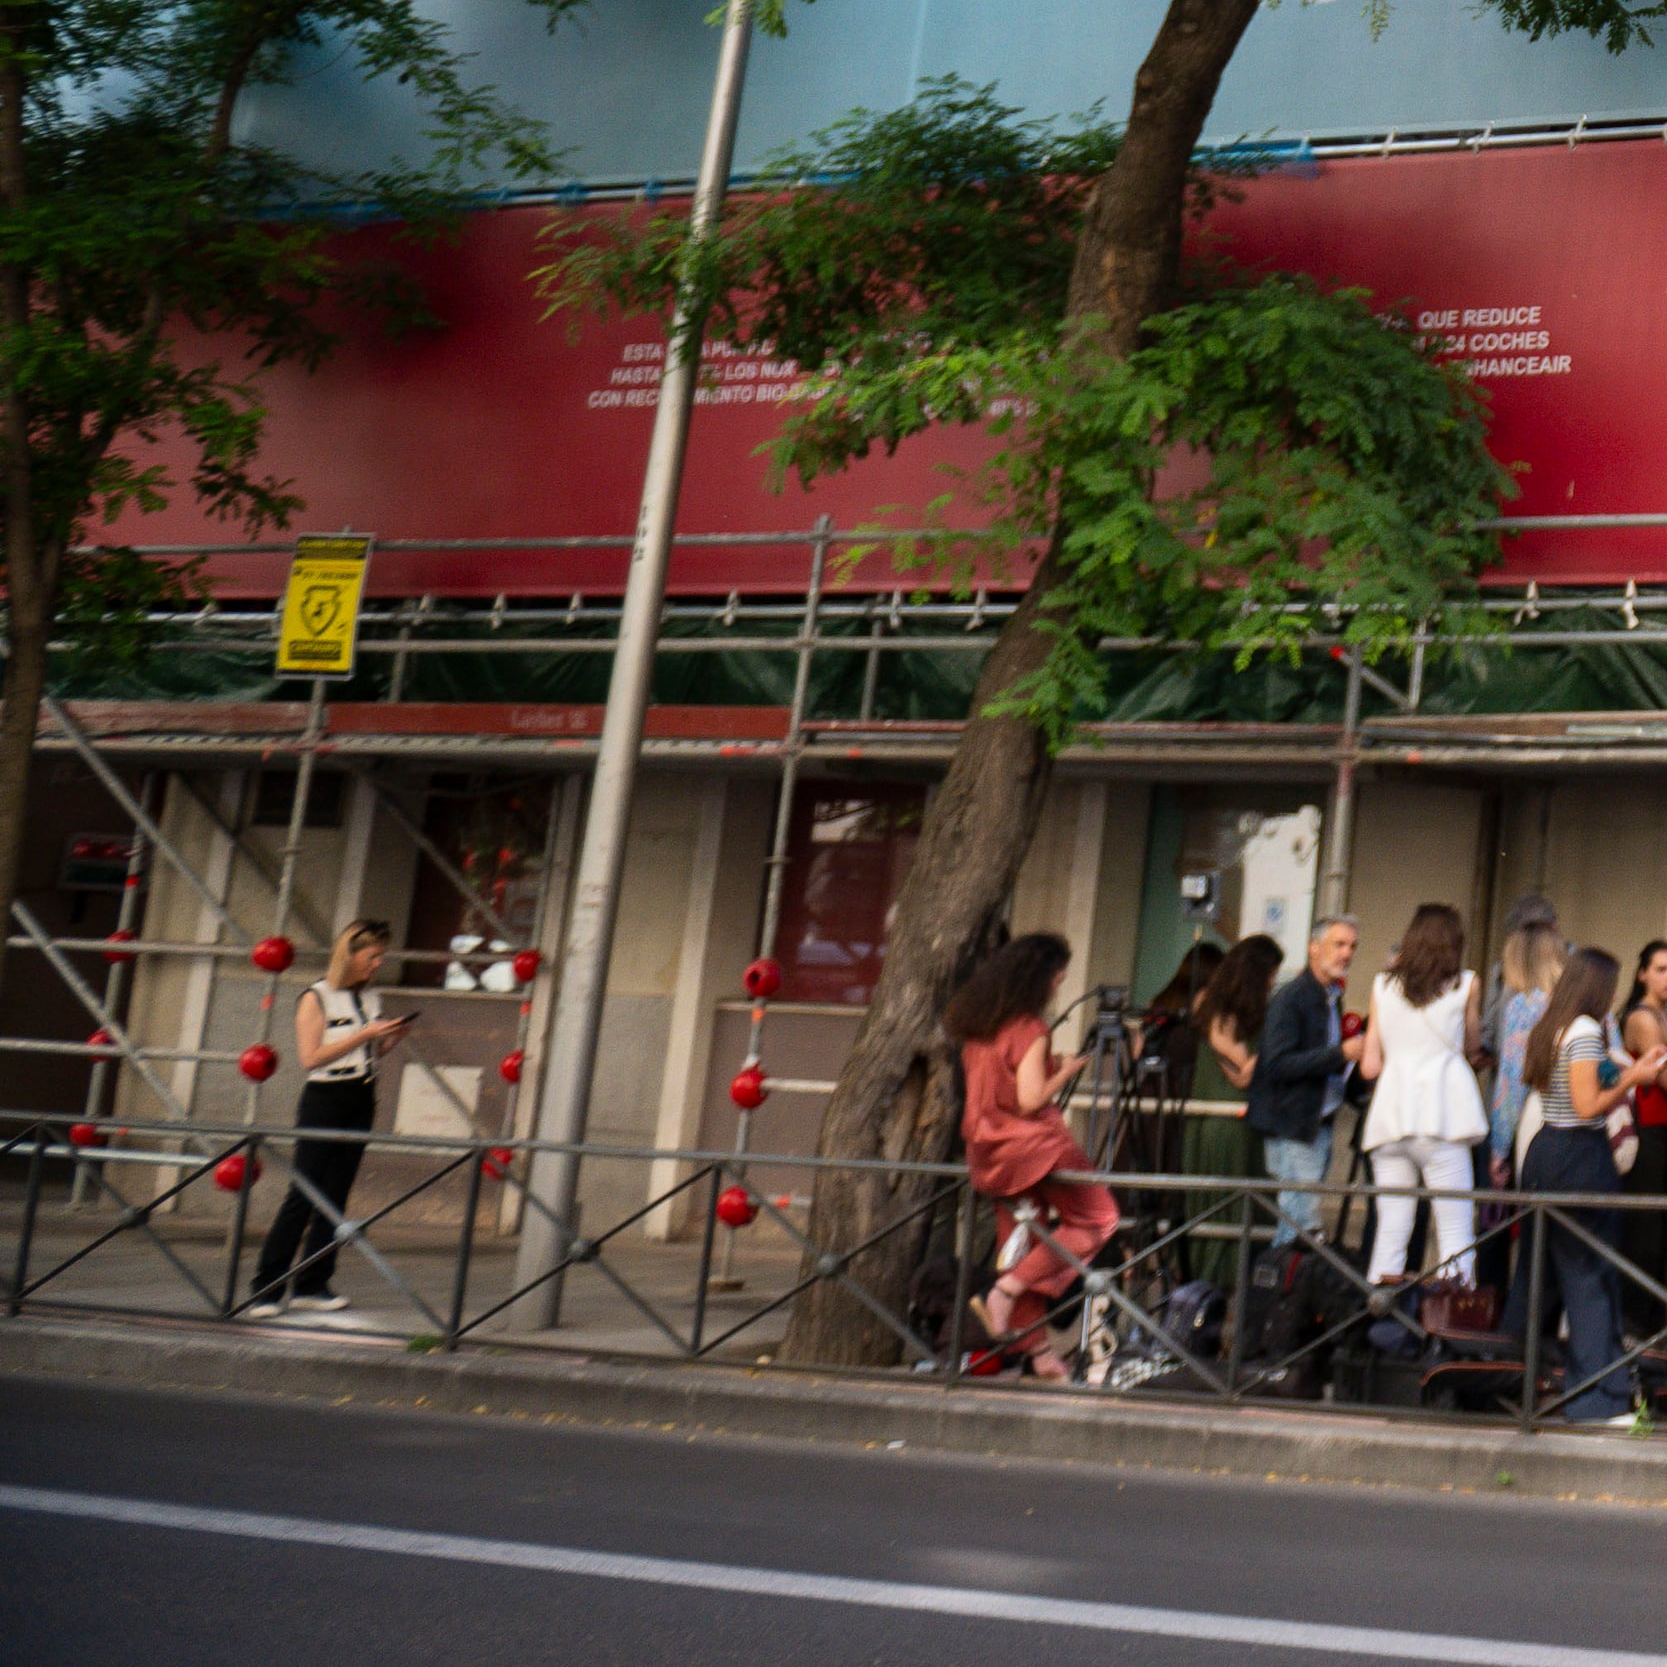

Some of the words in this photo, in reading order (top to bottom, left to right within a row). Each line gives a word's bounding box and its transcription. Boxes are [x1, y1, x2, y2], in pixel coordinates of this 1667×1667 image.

[1417, 309, 1459, 330] QUE
[1463, 306, 1542, 327] REDUCE
[1470, 331, 1550, 352] COCHES
[623, 344, 662, 362] ESTA
[610, 365, 662, 384] HASTA
[725, 362, 758, 381] LOS
[587, 390, 622, 409] CON
